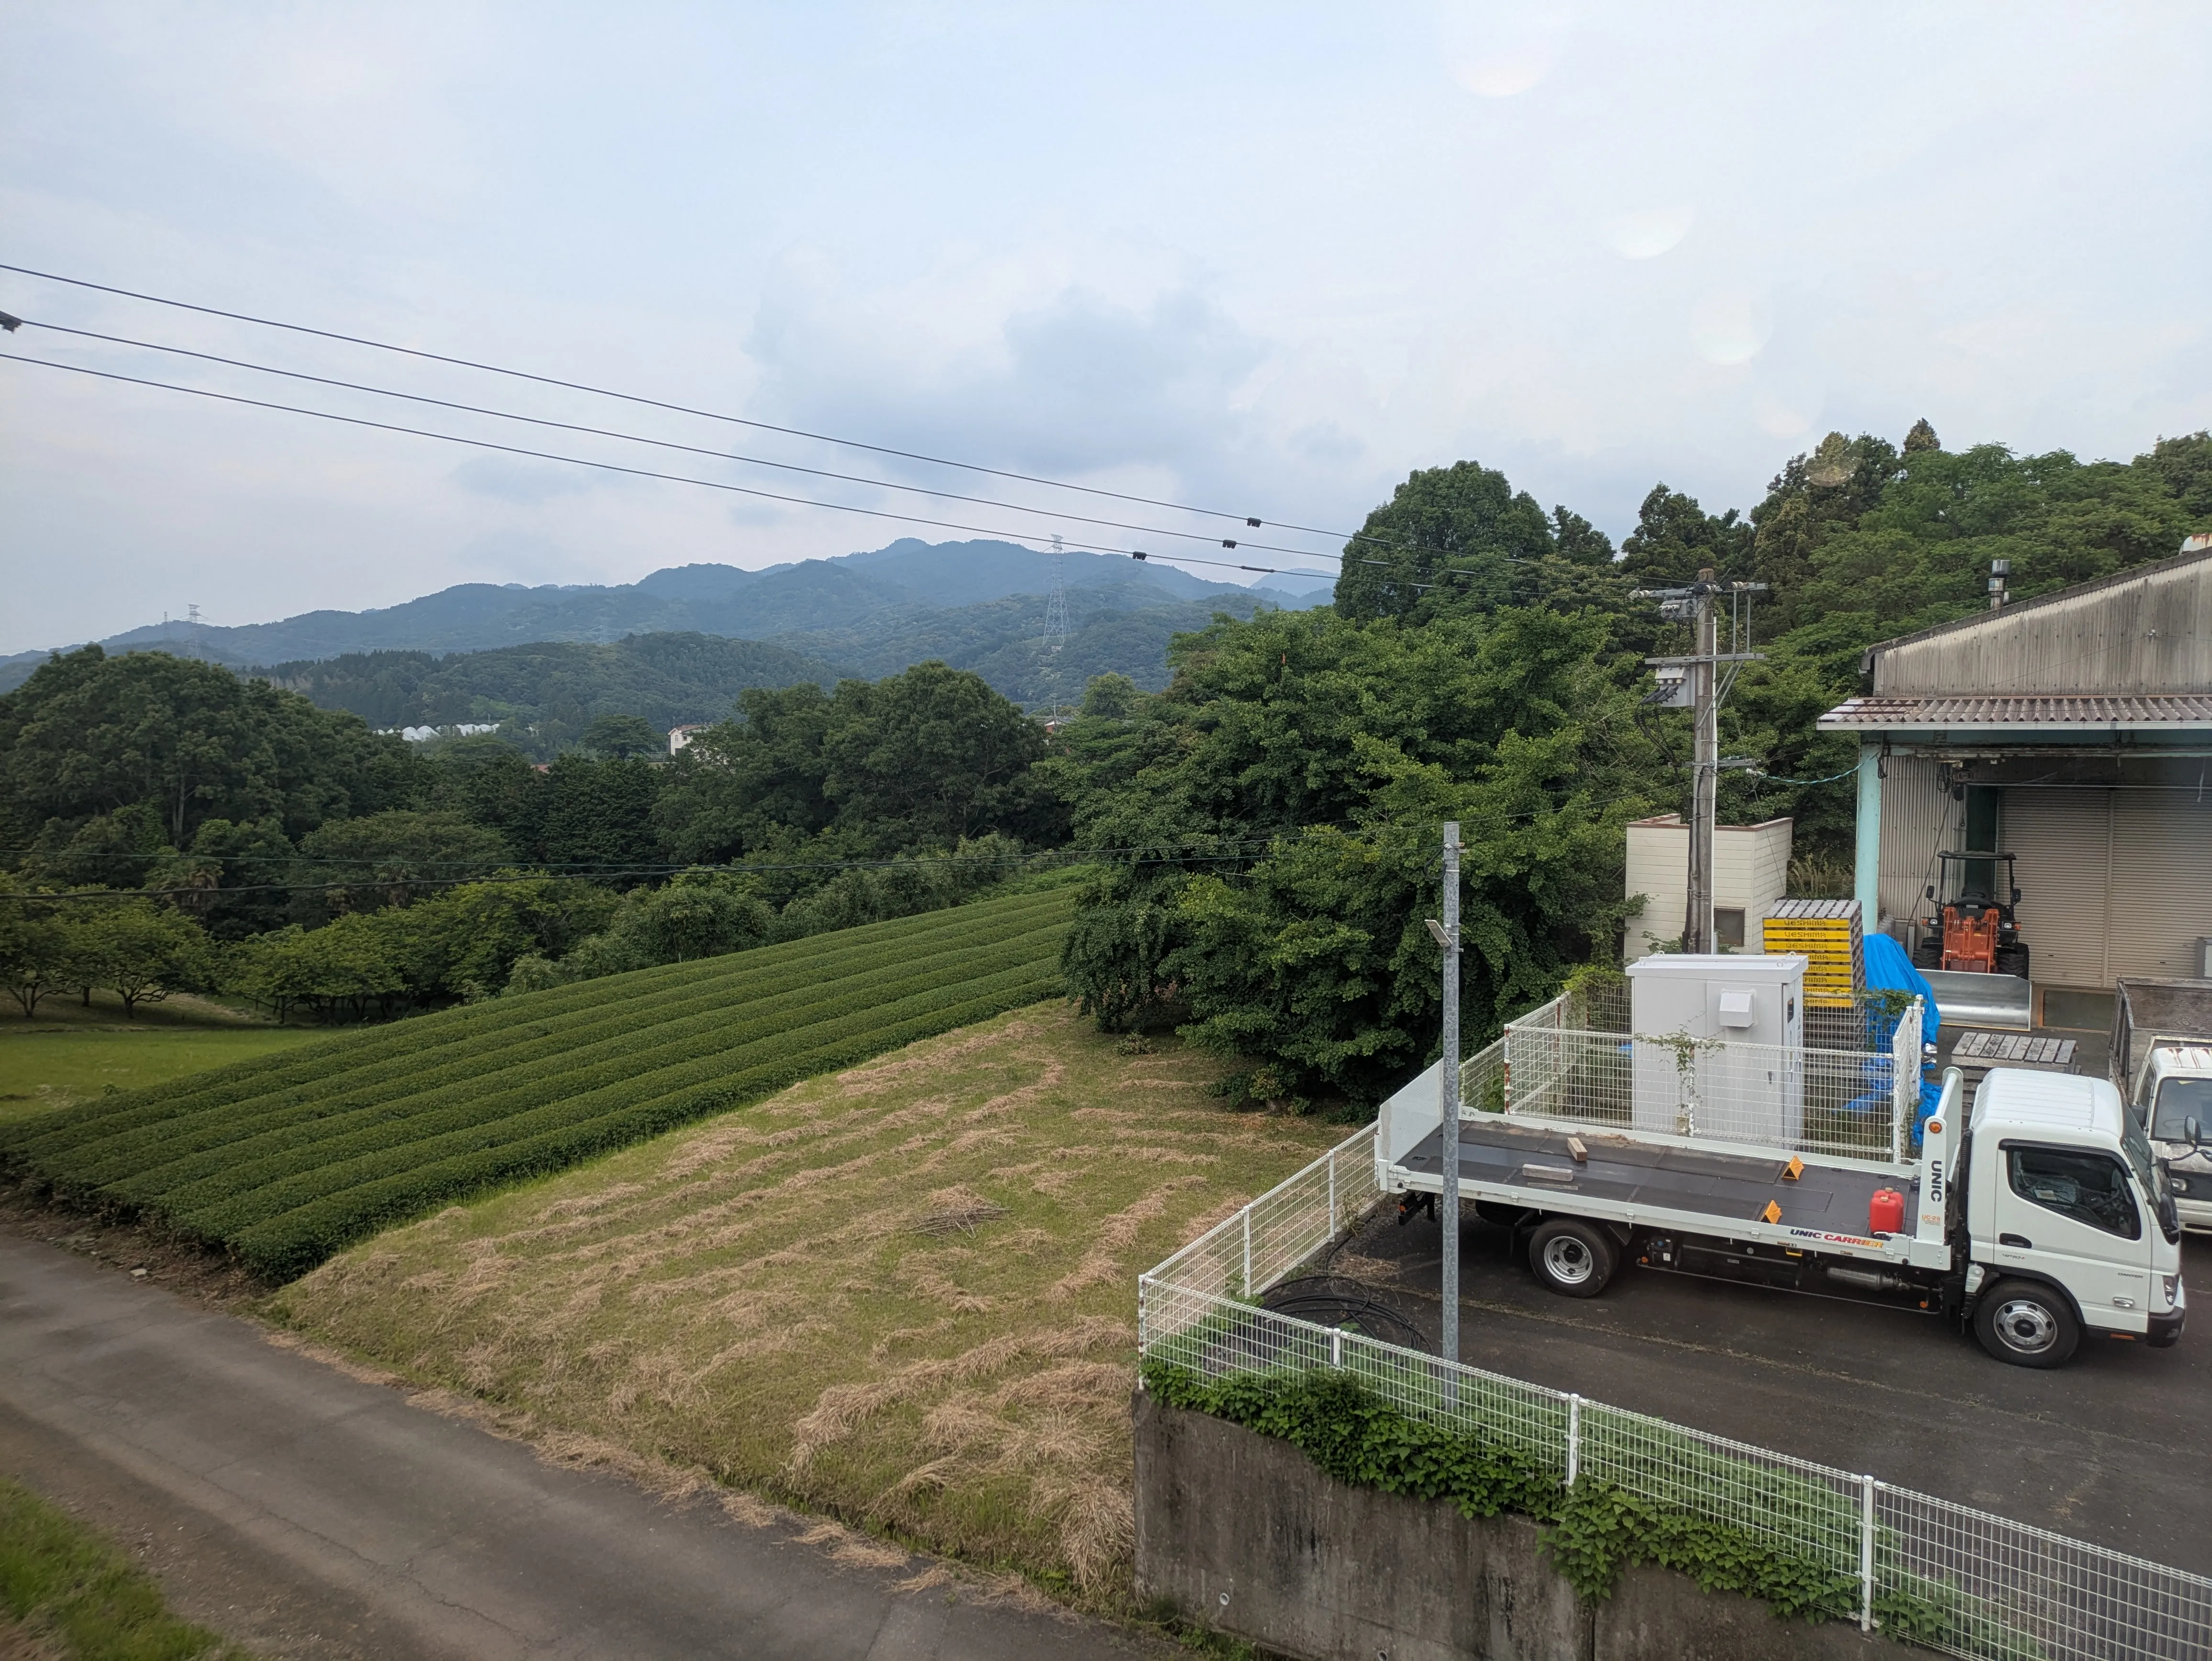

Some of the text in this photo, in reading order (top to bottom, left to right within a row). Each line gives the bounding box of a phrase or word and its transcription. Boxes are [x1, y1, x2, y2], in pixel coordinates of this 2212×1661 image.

[1930, 1160, 1942, 1202] UNIC
[1790, 1229, 1884, 1248] UNIC CARRIER
